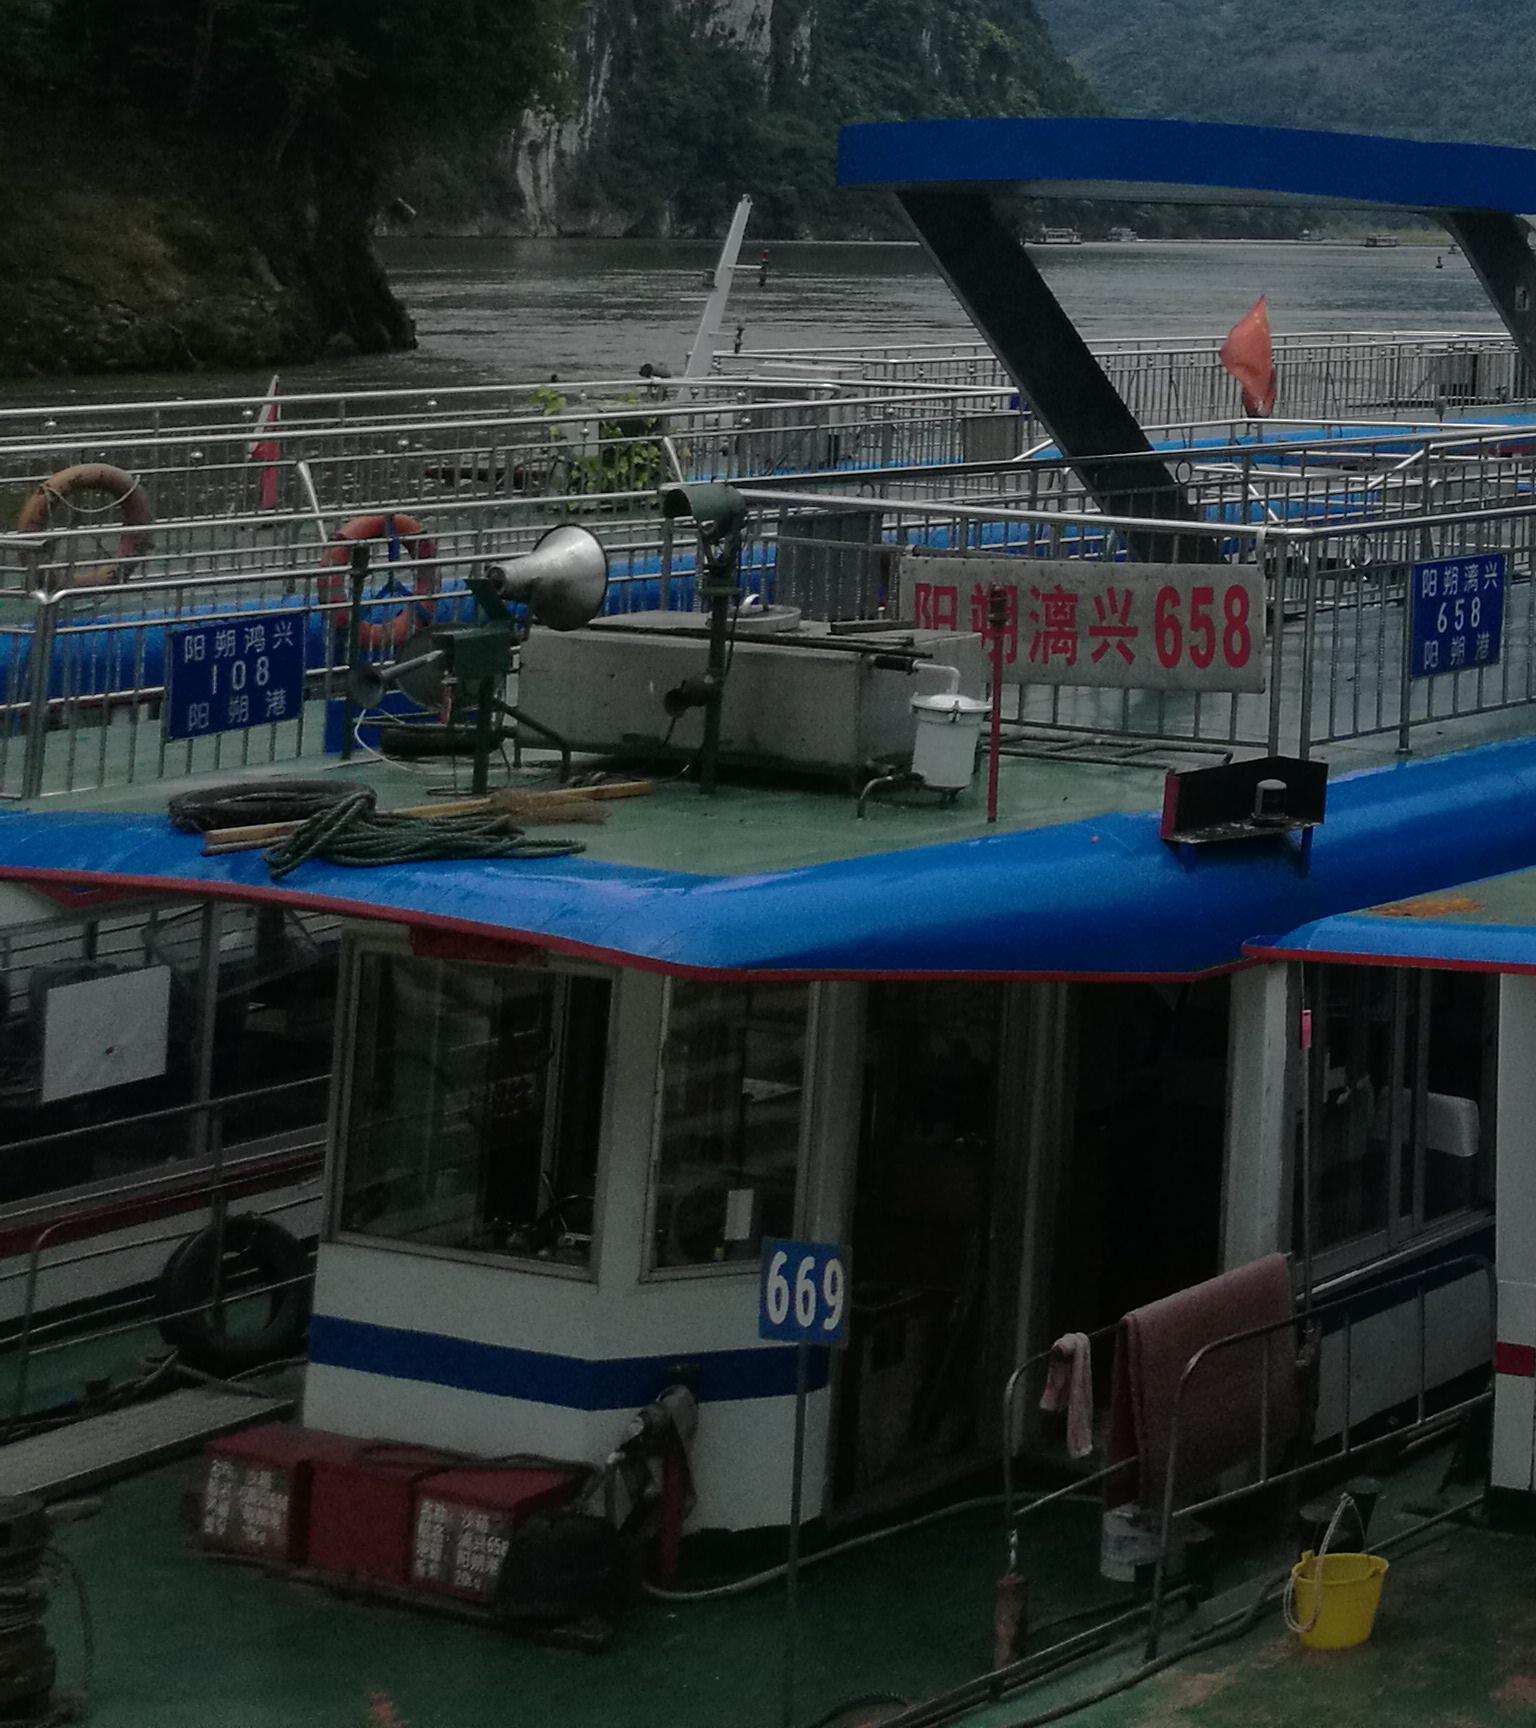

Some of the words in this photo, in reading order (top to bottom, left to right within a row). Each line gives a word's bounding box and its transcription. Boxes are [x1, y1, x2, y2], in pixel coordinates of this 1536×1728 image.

[1422, 560, 1498, 598] 阳朔漓兴
[1437, 596, 1481, 633] 658
[184, 620, 294, 663] 阳朔鸿兴
[1424, 631, 1491, 670] 阳朔港
[211, 656, 270, 695] 108
[187, 688, 287, 732] 阳朔港
[767, 1250, 844, 1331] 669
